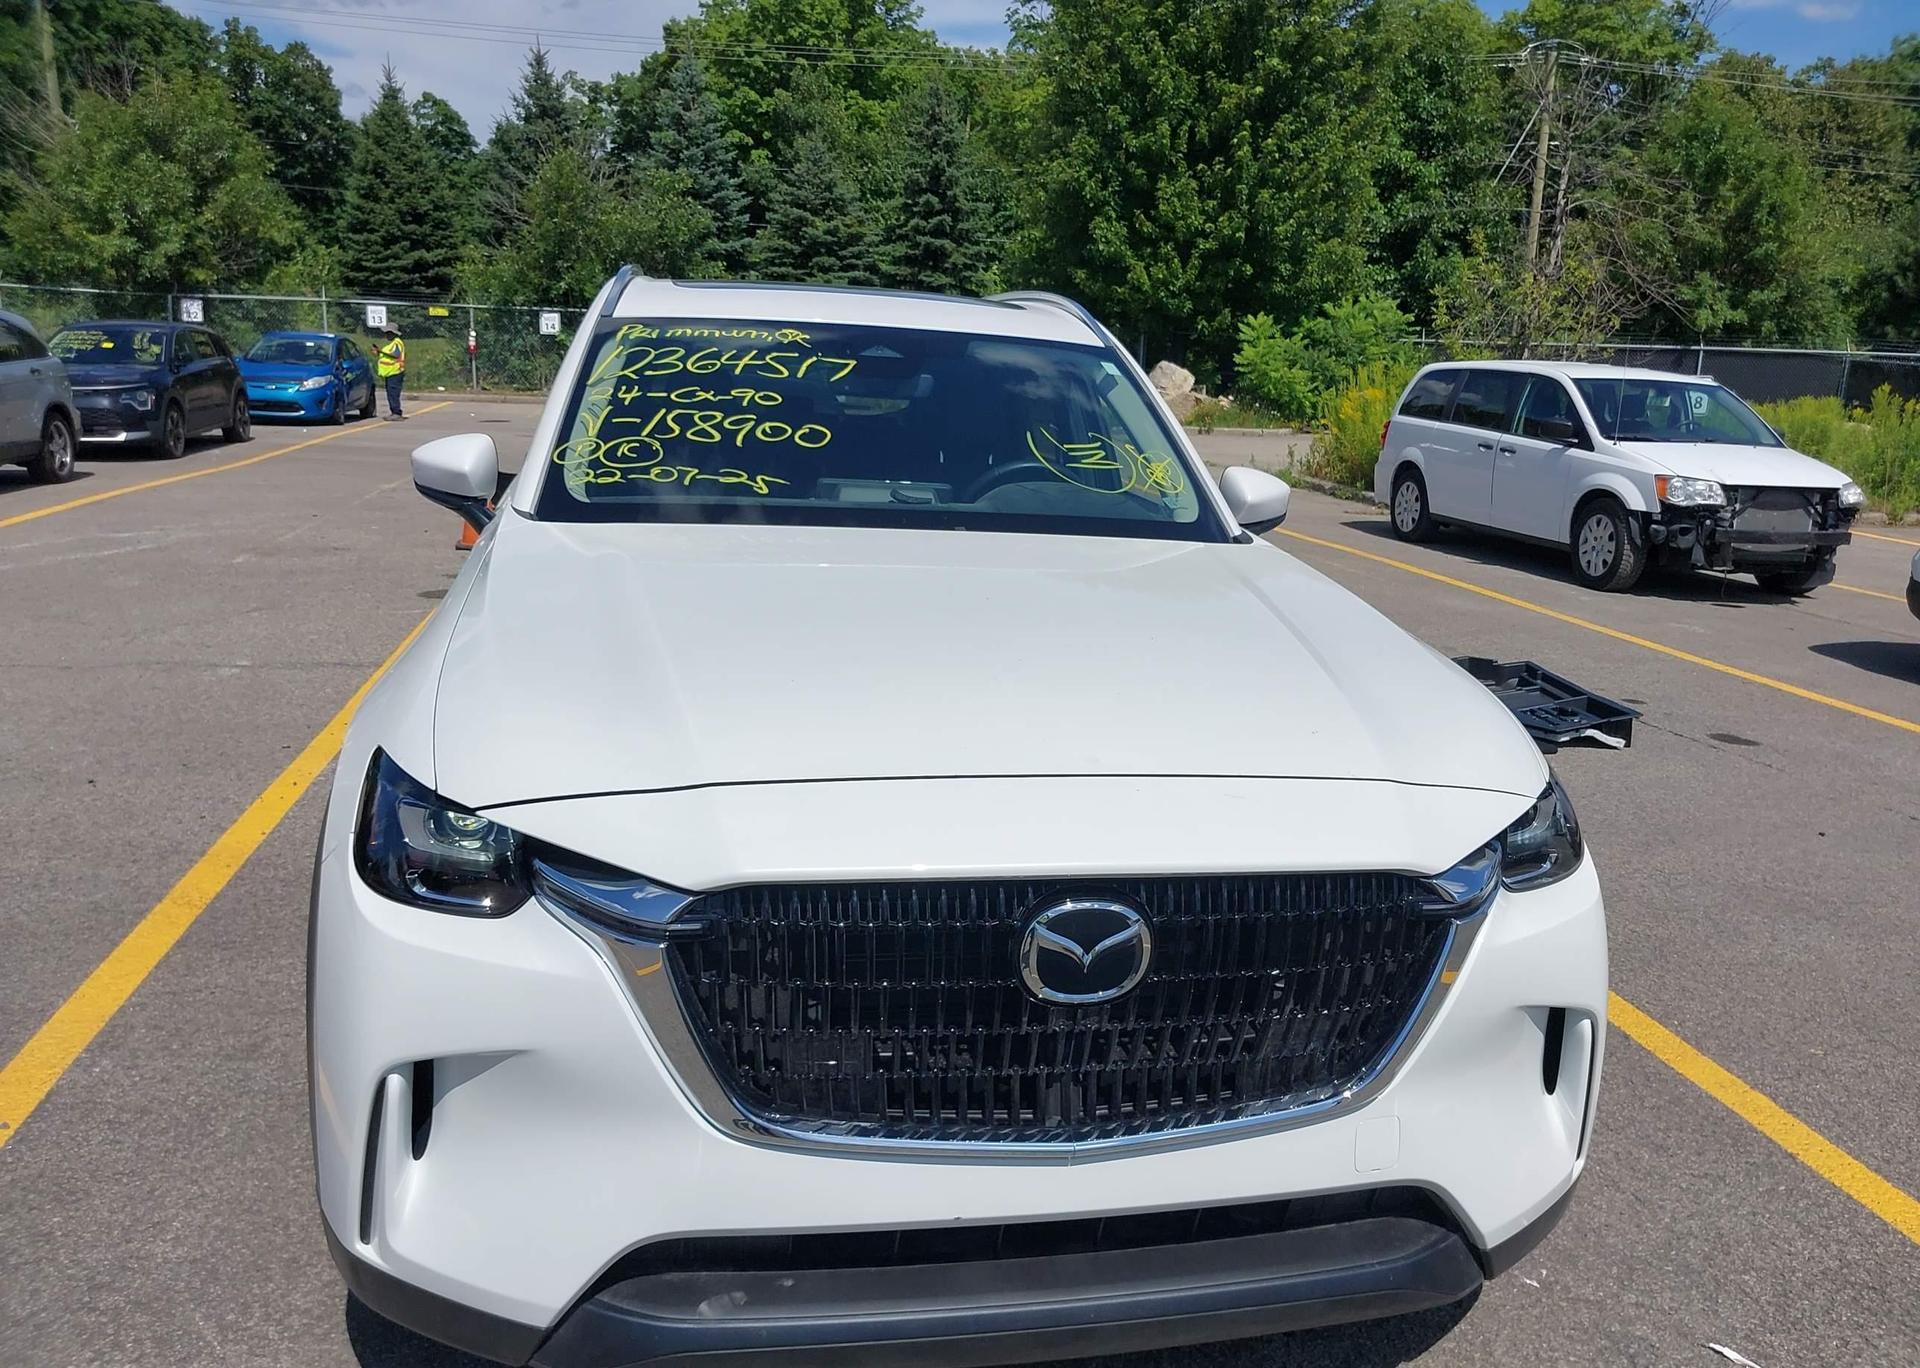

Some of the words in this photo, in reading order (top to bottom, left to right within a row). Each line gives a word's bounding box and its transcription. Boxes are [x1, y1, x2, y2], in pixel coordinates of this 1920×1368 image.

[372, 316, 383, 324] 13
[545, 322, 556, 330] 14
[1693, 396, 1703, 409] 8
